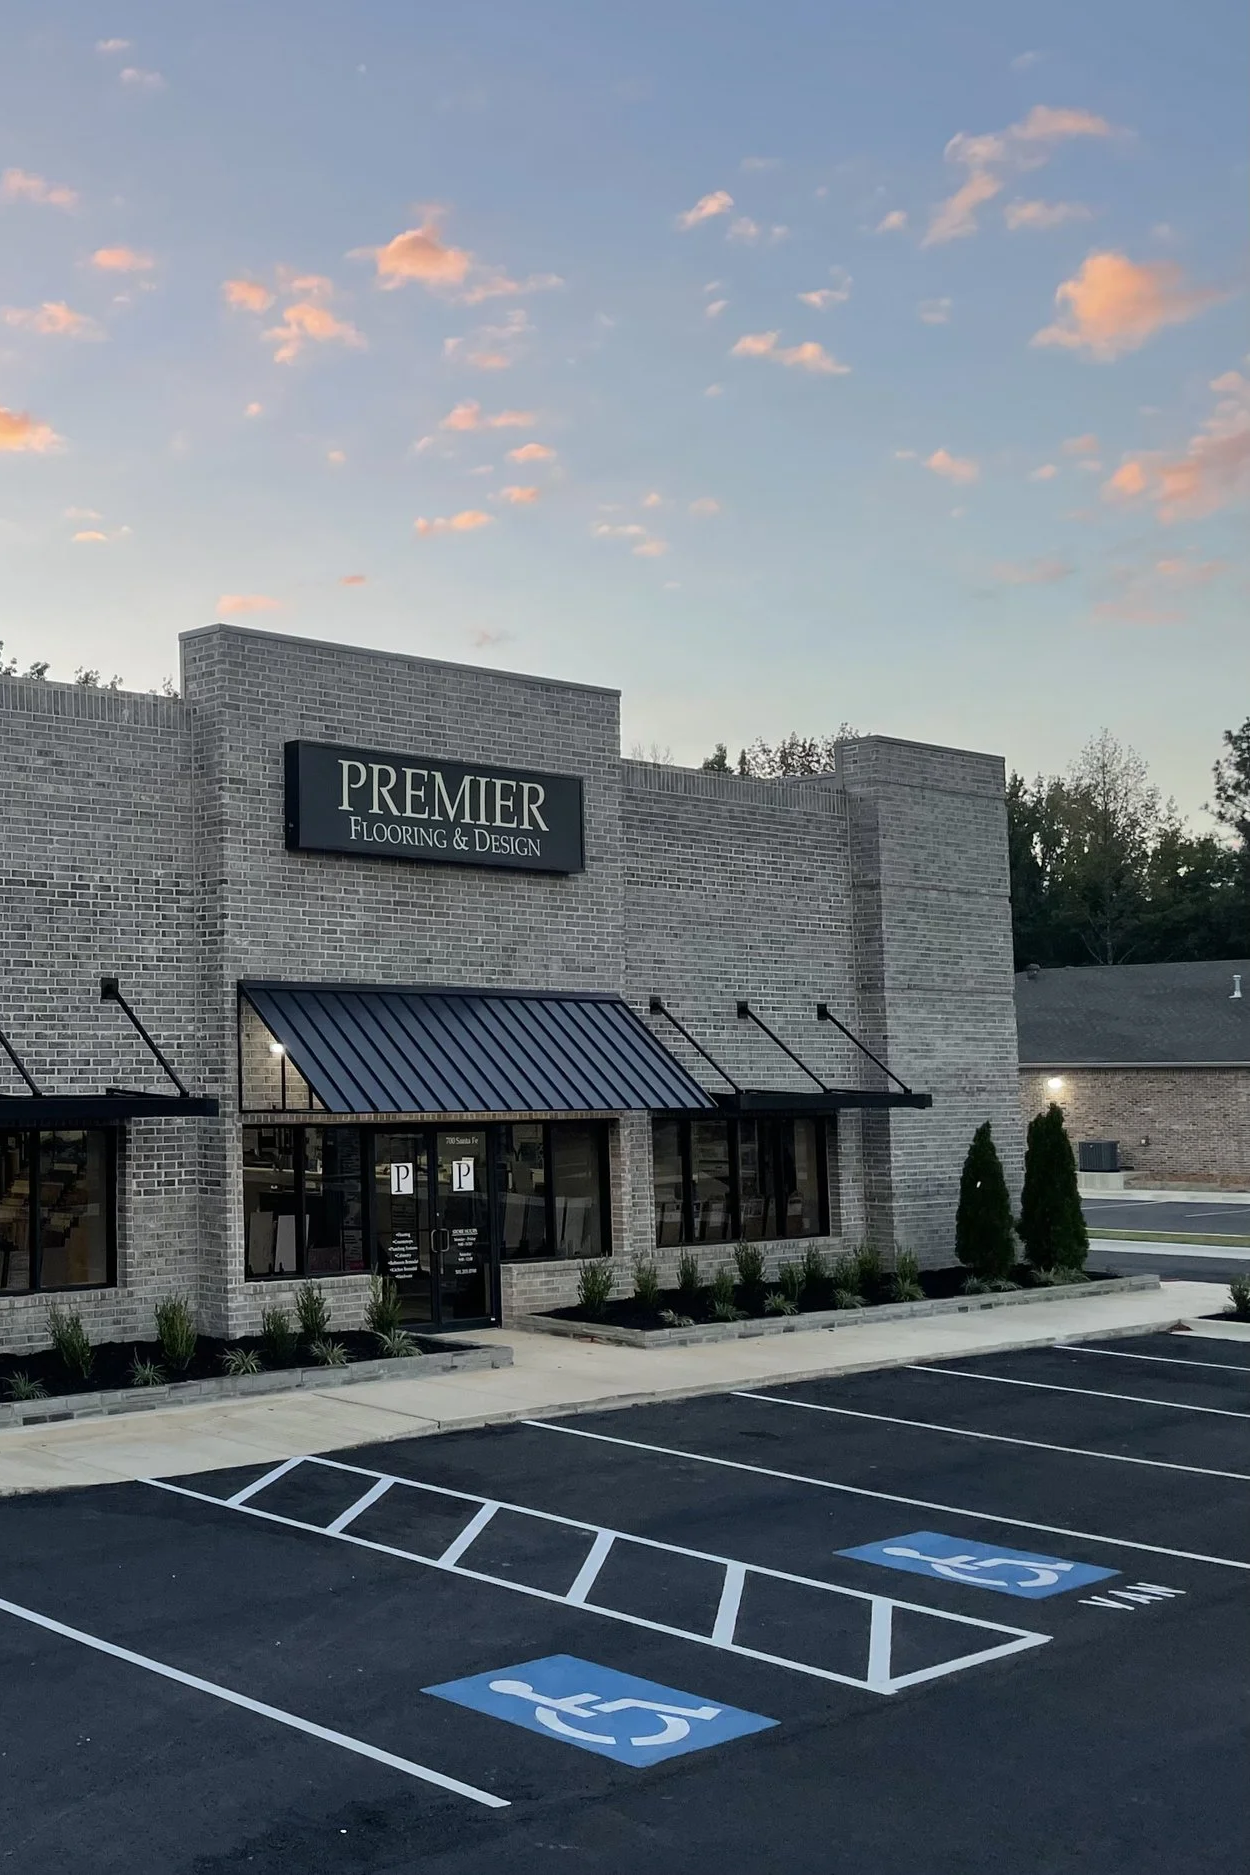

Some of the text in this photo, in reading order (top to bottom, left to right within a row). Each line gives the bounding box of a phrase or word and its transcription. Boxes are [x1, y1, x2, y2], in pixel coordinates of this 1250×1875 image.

[337, 759, 550, 832] PREMIER
[349, 816, 541, 857] FLOORING & DESIGN
[394, 1165, 409, 1192] P
[456, 1162, 470, 1189] P
[1077, 1582, 1187, 1611] VAN
